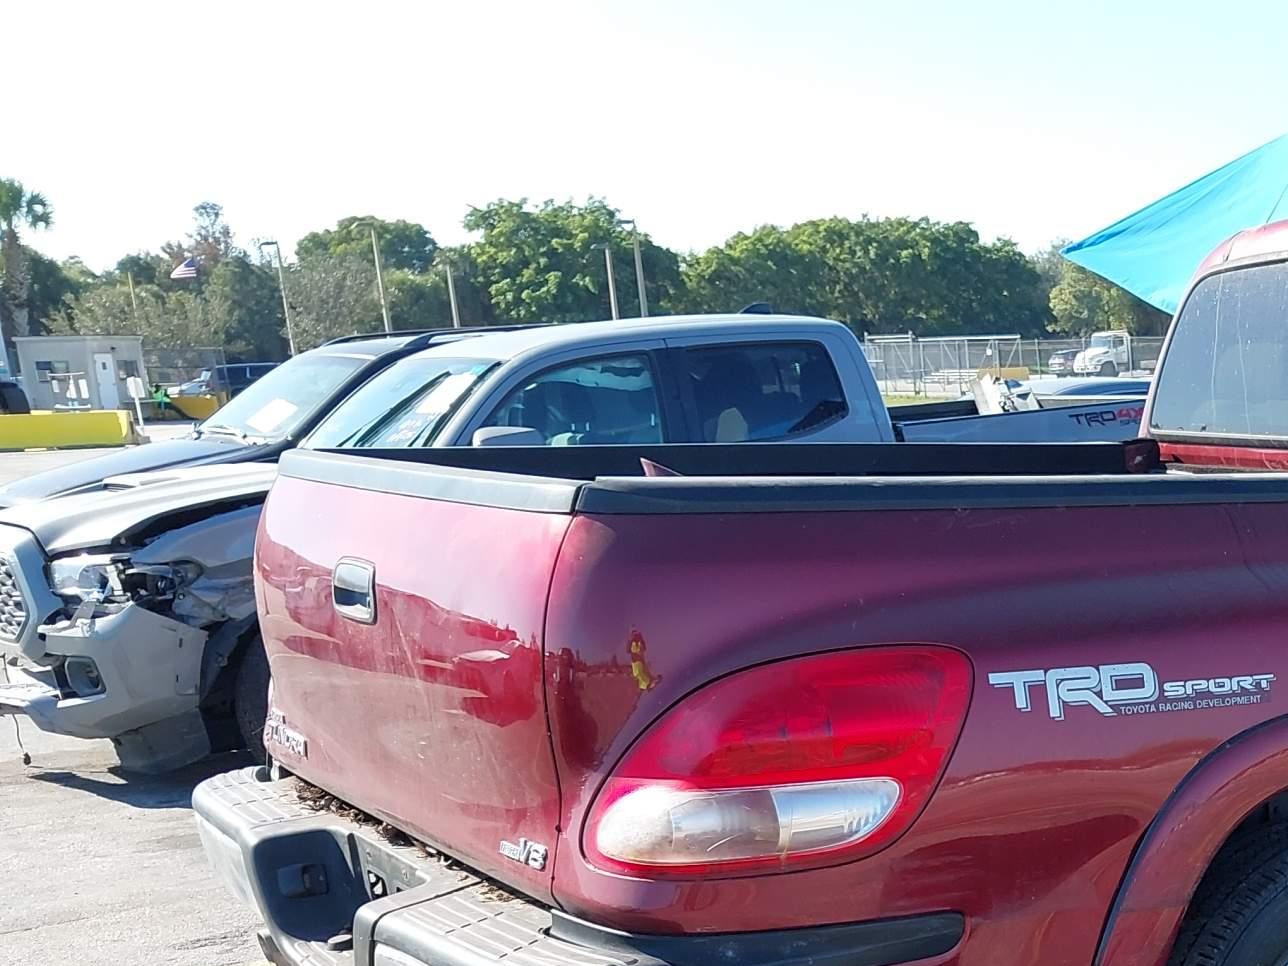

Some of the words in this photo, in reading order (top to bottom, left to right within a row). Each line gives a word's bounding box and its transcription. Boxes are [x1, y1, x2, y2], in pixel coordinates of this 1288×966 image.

[1068, 411, 1116, 426] TRD
[987, 662, 1159, 720] TRD
[1163, 673, 1276, 699] SPORT
[1119, 703, 1157, 715] TOYOTA
[1158, 700, 1194, 712] RACING
[1196, 694, 1262, 709] DEVELOPMENT
